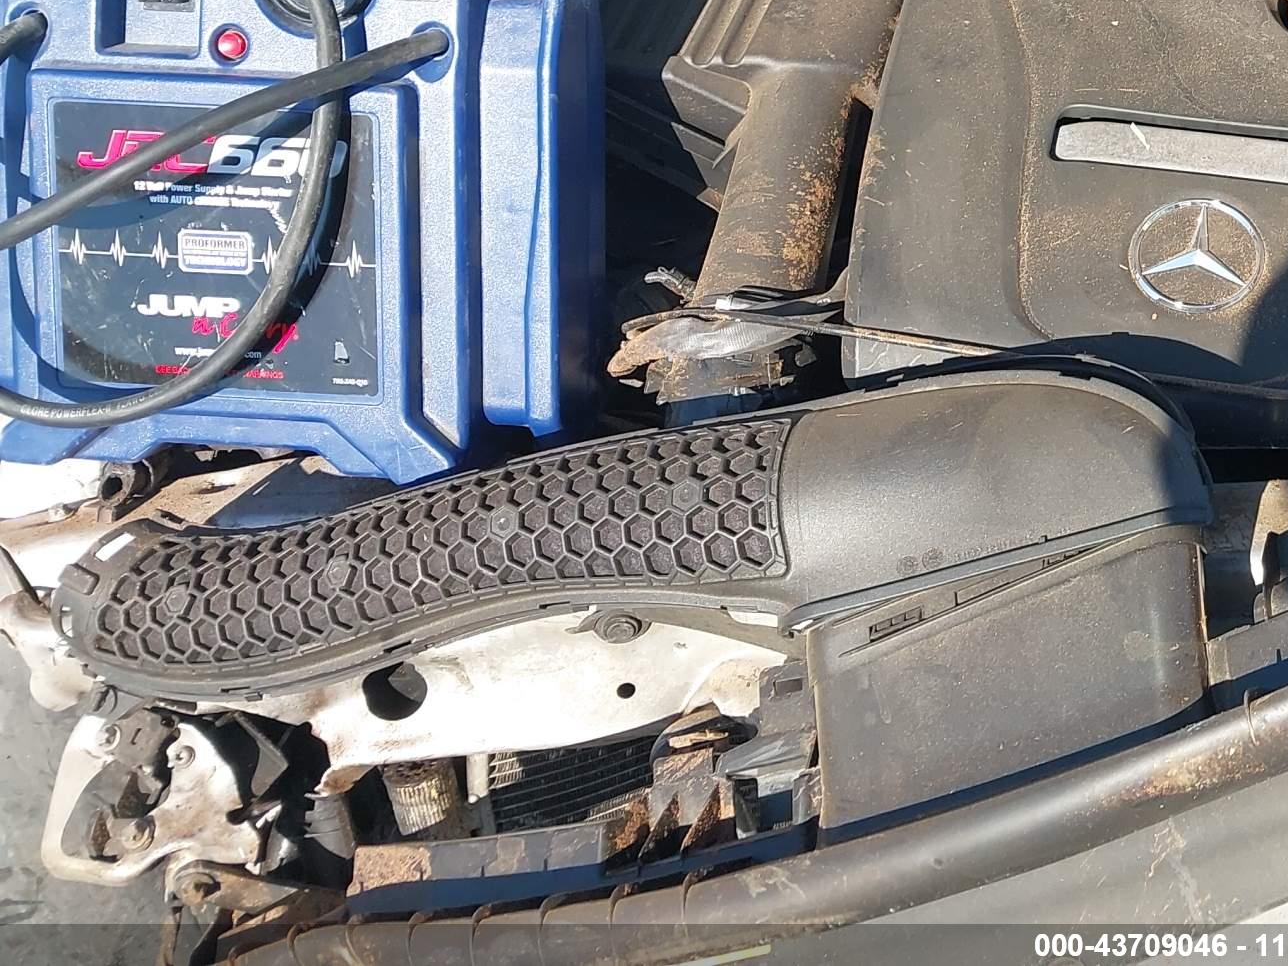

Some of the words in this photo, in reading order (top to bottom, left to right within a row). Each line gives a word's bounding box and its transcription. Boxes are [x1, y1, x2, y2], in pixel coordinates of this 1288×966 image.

[165, 183, 193, 193] Power
[195, 184, 225, 196] Supply
[149, 194, 168, 204] with
[170, 195, 194, 205] AUTO
[185, 238, 245, 250] PROFORMER
[136, 293, 240, 318] JUMP
